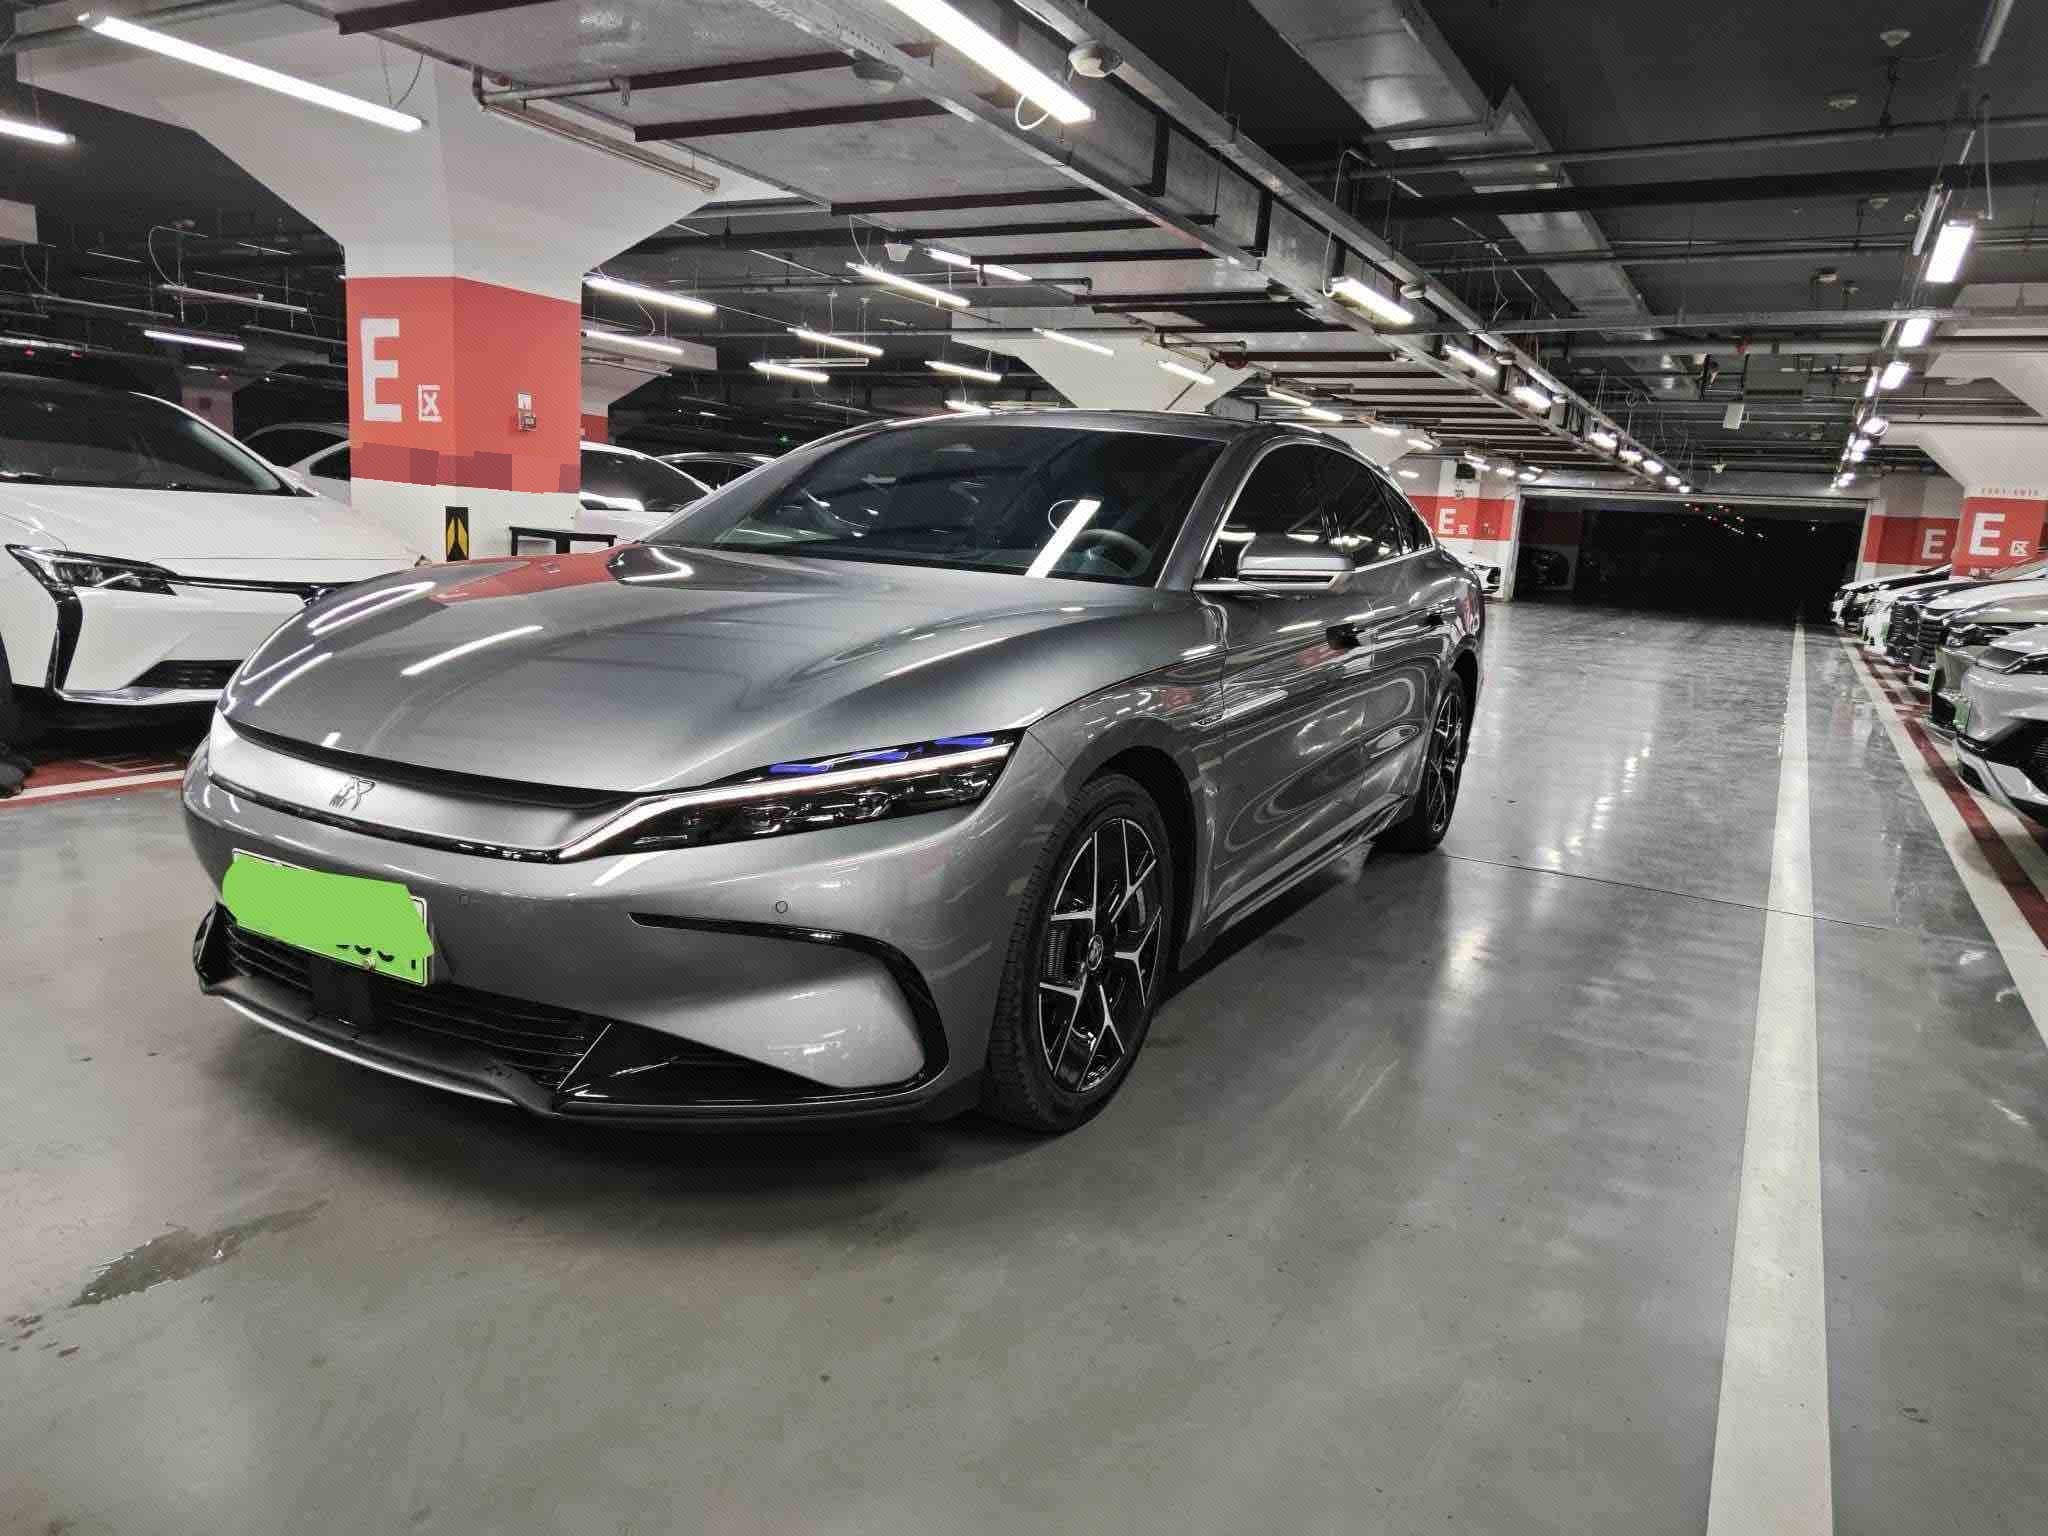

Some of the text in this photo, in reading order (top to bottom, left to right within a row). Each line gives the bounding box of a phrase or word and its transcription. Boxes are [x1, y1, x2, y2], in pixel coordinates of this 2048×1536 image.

[361, 318, 442, 422] E 区
[1439, 508, 1457, 534] E
[1969, 512, 2005, 556] E
[1922, 529, 1946, 559] E
